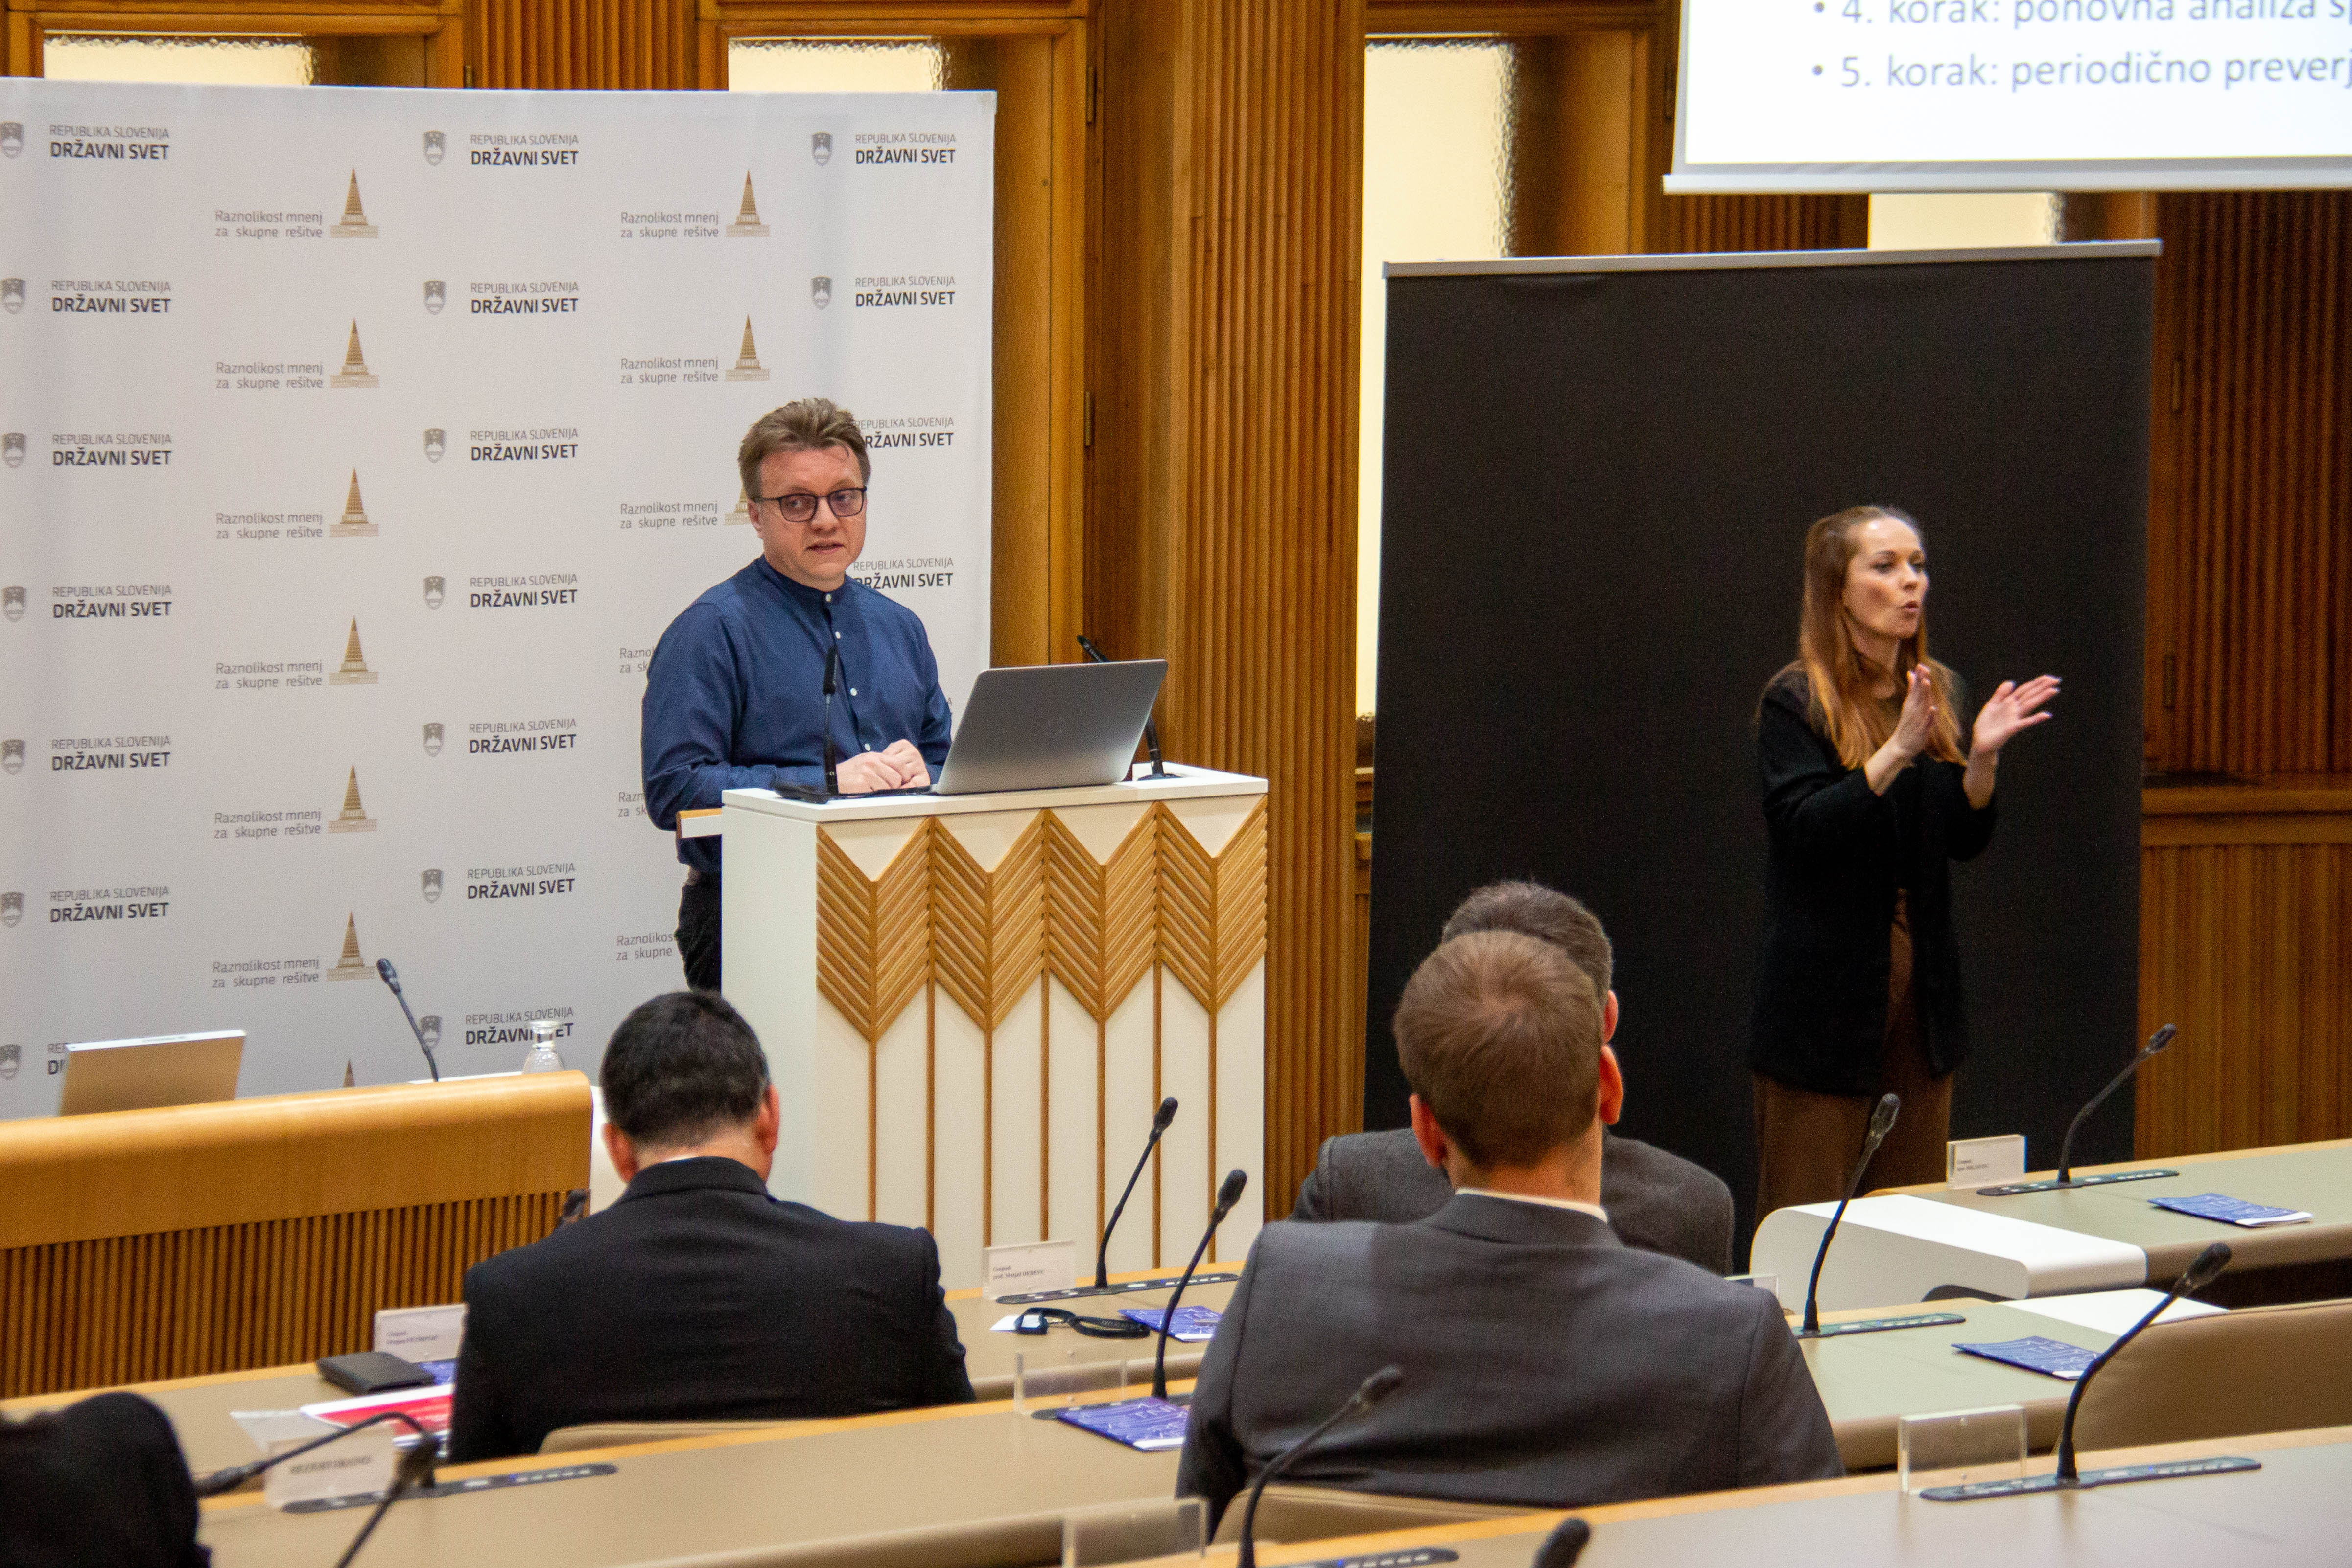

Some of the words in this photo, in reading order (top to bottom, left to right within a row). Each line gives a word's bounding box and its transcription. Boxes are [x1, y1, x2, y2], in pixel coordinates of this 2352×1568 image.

[1889, 0, 1999, 23] korak:
[2014, 0, 2173, 29] ponovna
[1841, 56, 1871, 87] 5.
[1887, 53, 1998, 86] korak:
[2012, 50, 2211, 93] periodično
[50, 125, 111, 137] REPUBLIKA
[114, 127, 169, 140] SLOVENIJA
[470, 135, 527, 145] REPUBLIKA
[530, 134, 578, 145] SLOVENIJA
[856, 134, 906, 143] REPUBLIKA
[909, 133, 956, 144] SLOVENIJA
[50, 139, 124, 159] DRŽAVNI
[129, 144, 169, 160] SVET
[471, 147, 538, 166] DRŽAVNI
[541, 150, 579, 165] SVET
[856, 146, 917, 164] DRŽAVNI
[921, 149, 956, 164] SVET
[216, 210, 282, 222] Raznolikost
[286, 212, 323, 225] mnenj
[621, 212, 682, 223] Raznolikost
[685, 213, 719, 225] mnenj
[216, 228, 228, 236] za
[236, 226, 279, 239] skupne
[286, 226, 323, 238] rešitve
[621, 230, 632, 238] za
[640, 227, 677, 239] skupne
[684, 226, 719, 237] rešitve
[51, 280, 113, 291] REPUBLIKA
[116, 281, 171, 293] SLOVENIJA
[471, 283, 527, 293] REPUBLIKA
[530, 282, 579, 293] SLOVENIJA
[856, 277, 906, 287] REPUBLIKA
[909, 276, 955, 286] SLOVENIJA
[52, 294, 126, 313] DRŽAVNI
[130, 298, 171, 313] SVET
[471, 296, 538, 314] DRŽAVNI
[542, 298, 579, 313] SVET
[856, 289, 917, 307] DRŽAVNI
[920, 291, 955, 305] SVET
[216, 362, 284, 374] Raznolikost
[288, 363, 323, 375] mnenj
[621, 358, 681, 369] Raznolikost
[684, 358, 718, 369] mnenj
[216, 380, 229, 389] za
[237, 378, 280, 390] skupne
[287, 377, 323, 388] rešitve
[639, 373, 677, 384] skupne
[683, 371, 718, 382] rešitve
[908, 417, 954, 428] SLOVENIJA
[52, 434, 113, 444] REPUBLIKA
[116, 434, 172, 445] SLOVENIJA
[471, 431, 527, 441] REPUBLIKA
[530, 428, 578, 440] SLOVENIJA
[865, 431, 915, 448] RŽAVNI
[919, 432, 954, 447] SVET
[53, 447, 126, 466] DRŽAVNI
[130, 449, 172, 466] SVET
[471, 443, 538, 461] DRŽAVNI
[541, 444, 578, 459] SVET
[620, 502, 680, 514] Raznolikost
[683, 501, 717, 513] mnenj
[216, 513, 284, 524] Raznolikost
[288, 513, 323, 524] mnenj
[639, 517, 676, 529] skupne
[682, 515, 717, 526] rešitve
[216, 530, 229, 539] za
[237, 528, 280, 540] skupne
[287, 526, 323, 538] rešitve
[853, 560, 904, 571] REPUBLIKA
[906, 557, 954, 569] SLOVENIJA
[470, 577, 526, 587] REPUBLIKA
[529, 574, 577, 585] SLOVENIJA
[918, 572, 954, 587] SVET
[53, 586, 113, 597] REPUBLIKA
[116, 585, 172, 596] SLOVENIJA
[470, 589, 537, 608] DRŽAVNI
[541, 589, 578, 605] SVET
[53, 599, 126, 618] DRŽAVNI
[130, 601, 172, 617] SVET
[216, 662, 283, 674] Raznolikost
[287, 661, 322, 673] mnenj
[619, 664, 631, 673] za
[216, 680, 229, 689] za
[237, 678, 279, 689] skupne
[286, 675, 322, 686] rešitve
[469, 722, 525, 733] REPUBLIKA
[528, 719, 576, 731] SLOVENIJA
[52, 738, 112, 749] REPUBLIKA
[115, 736, 171, 748] SLOVENIJA
[469, 735, 536, 753] DRŽAVNI
[540, 733, 577, 750] SVET
[52, 751, 125, 771] DRŽAVNI
[129, 751, 171, 768] SVET
[215, 811, 282, 823] Raznolikost
[286, 809, 321, 821] mnenj
[618, 808, 630, 817] za
[214, 830, 227, 839] za
[235, 826, 278, 839] skupne
[285, 823, 321, 835] rešitve
[468, 867, 523, 879] REPUBLIKA
[526, 863, 575, 876] SLOVENIJA
[50, 889, 110, 902] REPUBLIKA
[114, 886, 169, 898] SLOVENIJA
[468, 880, 535, 899] DRŽAVNI
[539, 878, 575, 895] SVET
[50, 903, 123, 923] DRŽAVNI
[128, 902, 169, 918] SVET
[617, 932, 674, 946] Raznolikos
[616, 952, 628, 960] za
[635, 948, 672, 959] skupne
[213, 960, 281, 973] Raznolikost
[284, 958, 319, 969] mnenj
[212, 980, 225, 988] za
[234, 976, 276, 987] skupne
[283, 972, 319, 983] rešitve
[466, 1012, 522, 1024] REPUBLIKA
[524, 1007, 573, 1021] SLOVENIJA
[466, 1026, 532, 1045] DRŽAVNI
